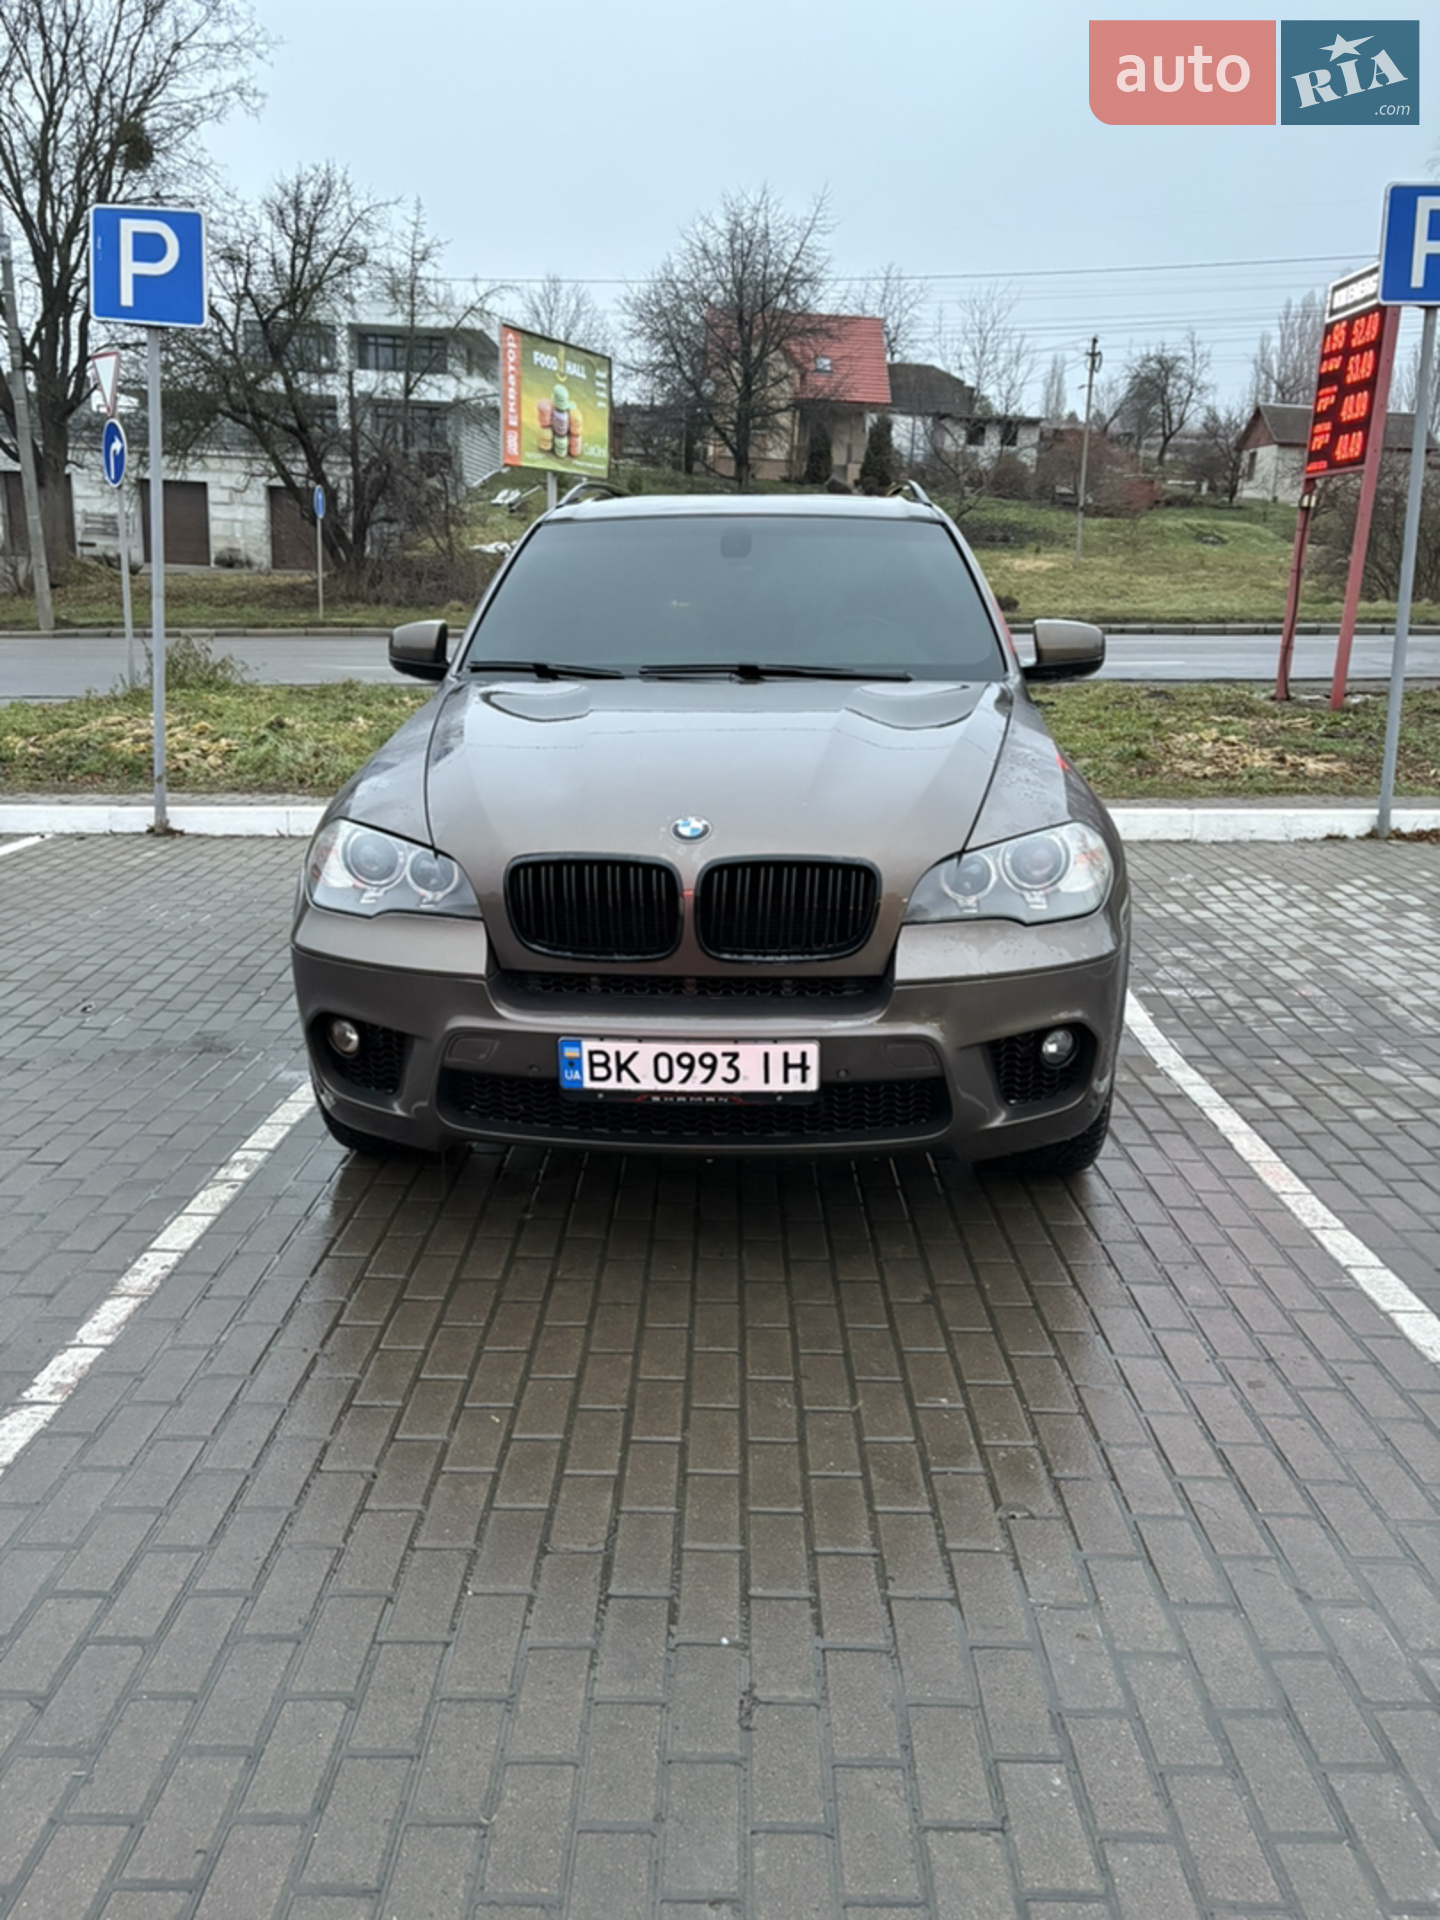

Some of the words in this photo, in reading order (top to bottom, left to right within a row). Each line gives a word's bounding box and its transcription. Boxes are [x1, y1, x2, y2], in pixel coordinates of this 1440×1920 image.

[119, 218, 180, 307] P
[532, 350, 559, 371] FOOD
[565, 359, 588, 380] HALL
[564, 1069, 582, 1081] UA
[588, 1049, 641, 1084] BK
[652, 1051, 742, 1085] 0993
[762, 1050, 809, 1085] IH
